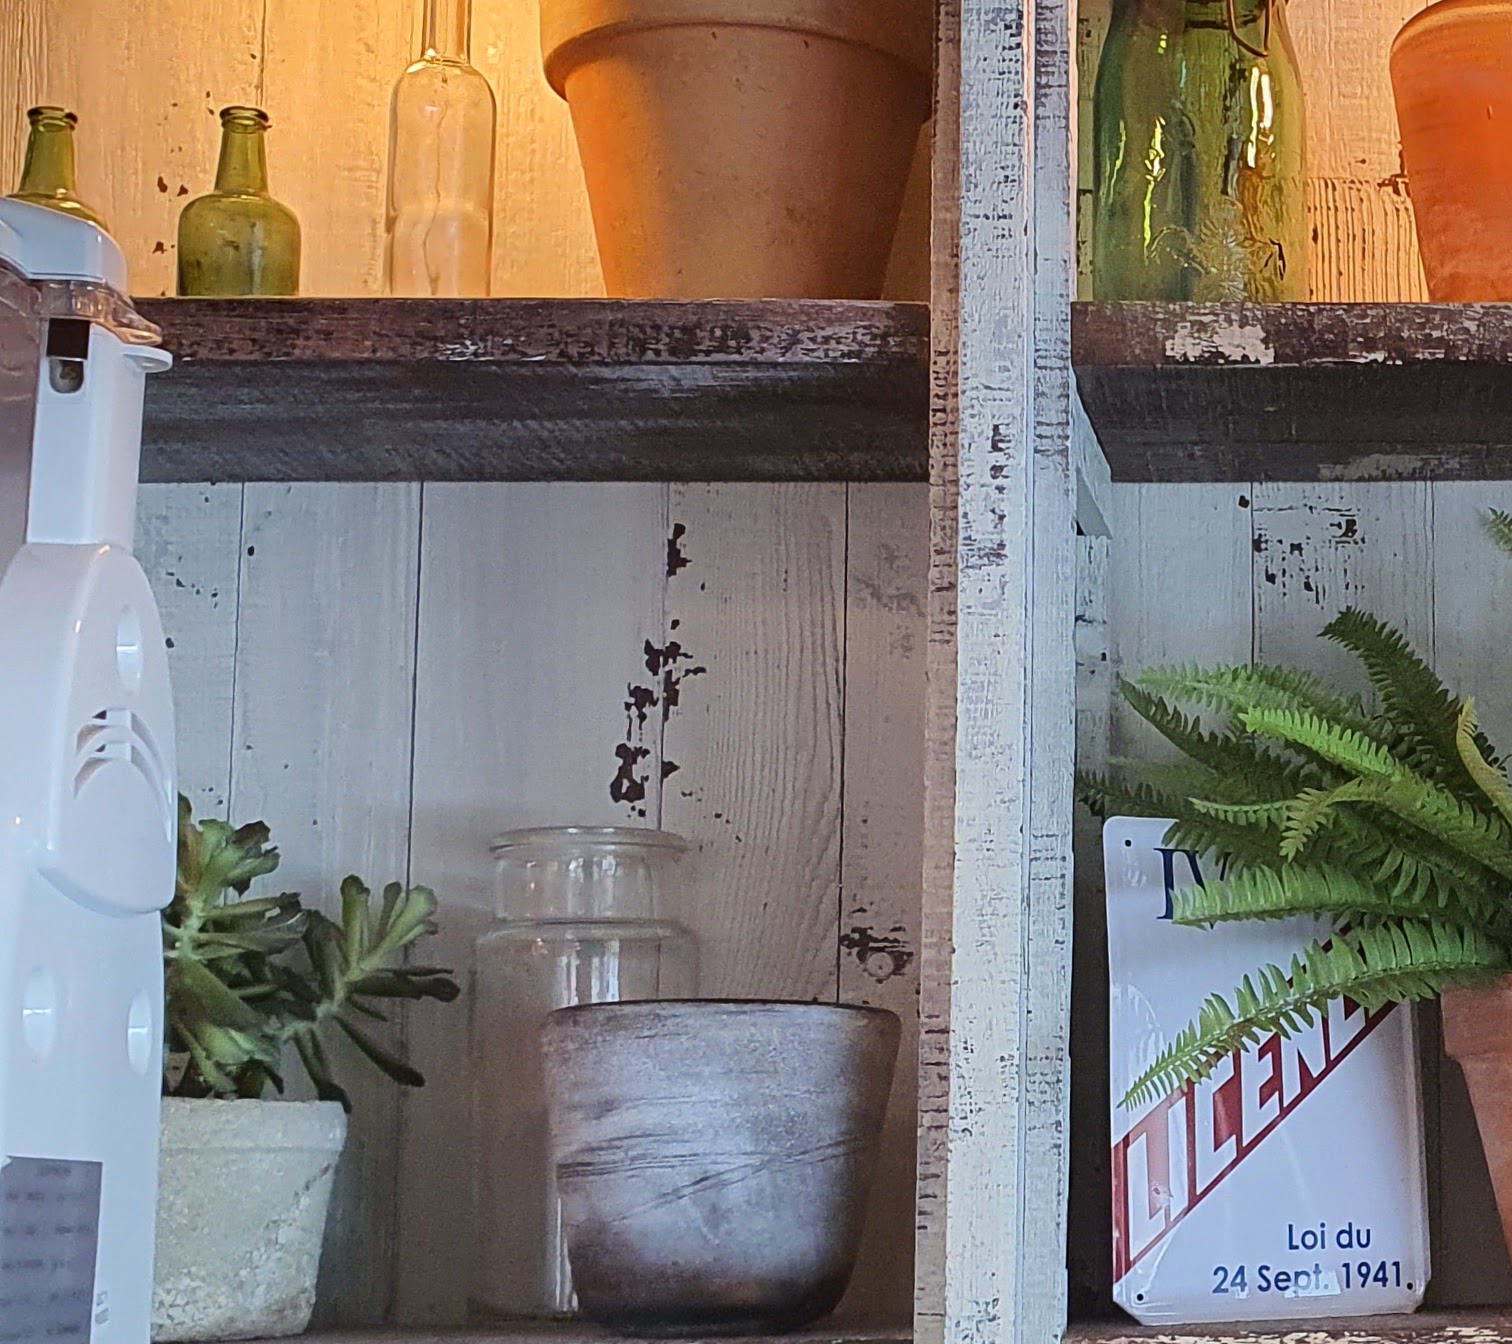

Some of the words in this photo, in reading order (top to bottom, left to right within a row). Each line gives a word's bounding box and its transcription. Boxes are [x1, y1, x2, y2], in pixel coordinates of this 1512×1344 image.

[1126, 981, 1390, 1262] LICEN
[1288, 1222, 1326, 1250] Loi
[1336, 1221, 1371, 1249] du
[1212, 1265, 1248, 1294] 24
[1257, 1263, 1330, 1296] Sept.
